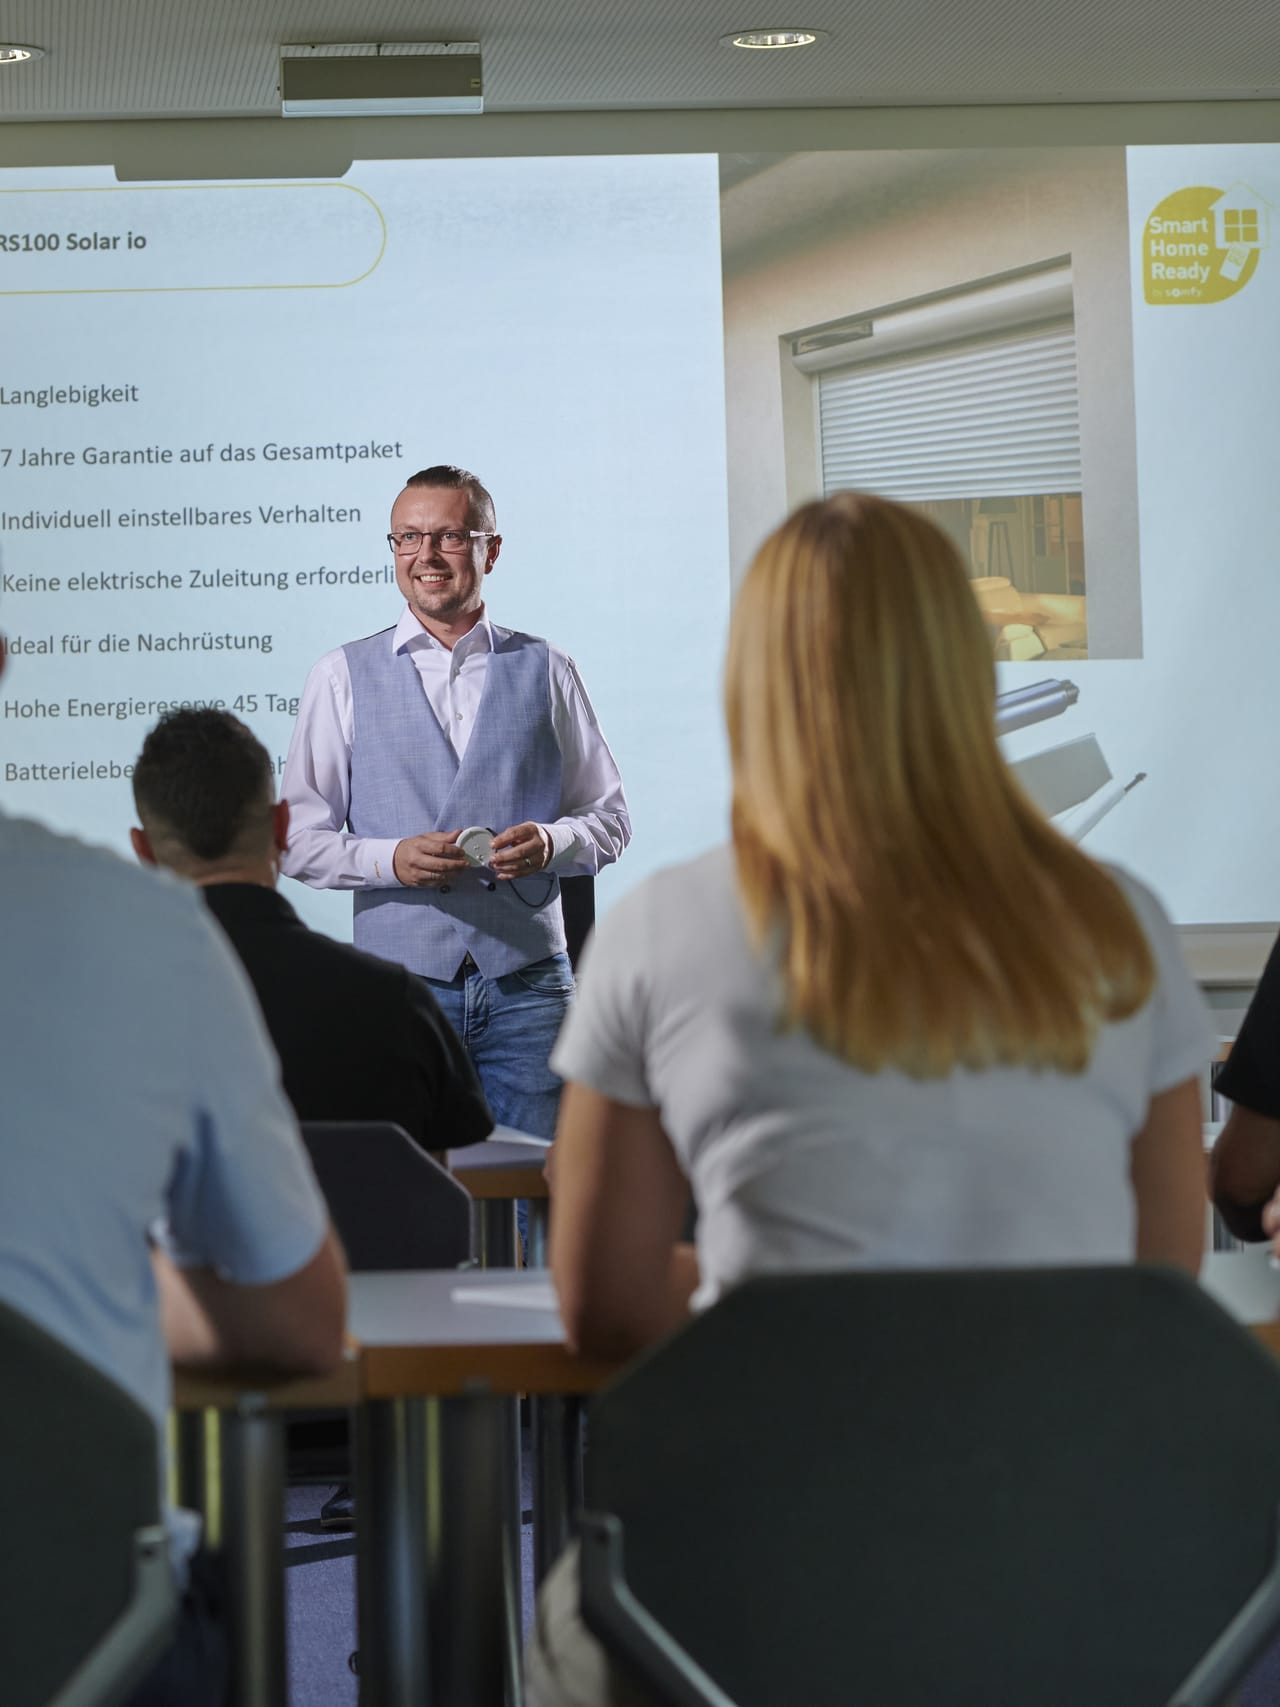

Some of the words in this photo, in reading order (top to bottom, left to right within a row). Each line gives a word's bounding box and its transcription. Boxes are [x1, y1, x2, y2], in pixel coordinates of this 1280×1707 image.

[1149, 217, 1209, 234] Smart
[66, 231, 120, 252] Solar
[127, 230, 147, 250] io
[1150, 240, 1209, 257] Home
[1151, 262, 1210, 284] Ready
[0, 383, 139, 408] Langlebigkeit
[0, 448, 12, 468] 7
[18, 446, 75, 468] Jahre
[82, 445, 174, 466] Garantie
[180, 443, 215, 464] auf
[220, 443, 255, 462] das
[262, 440, 403, 464] Gesamtpaket
[1, 508, 111, 531] Individuell
[118, 506, 252, 528] einstellbares
[259, 504, 361, 524] Verhalten
[2, 573, 61, 592] Keine
[68, 570, 182, 592] elektrische
[189, 567, 289, 591] Zuleitung
[296, 565, 394, 586] erforderli
[4, 635, 54, 655] Ideal
[61, 634, 92, 654] für
[98, 633, 131, 653] die
[138, 631, 273, 655] Nachrüstung
[4, 699, 61, 719] Hohe
[67, 697, 227, 720] Energiereserve
[232, 695, 258, 714] 45
[265, 693, 300, 716] Tag
[5, 759, 135, 782] Batterielebe
